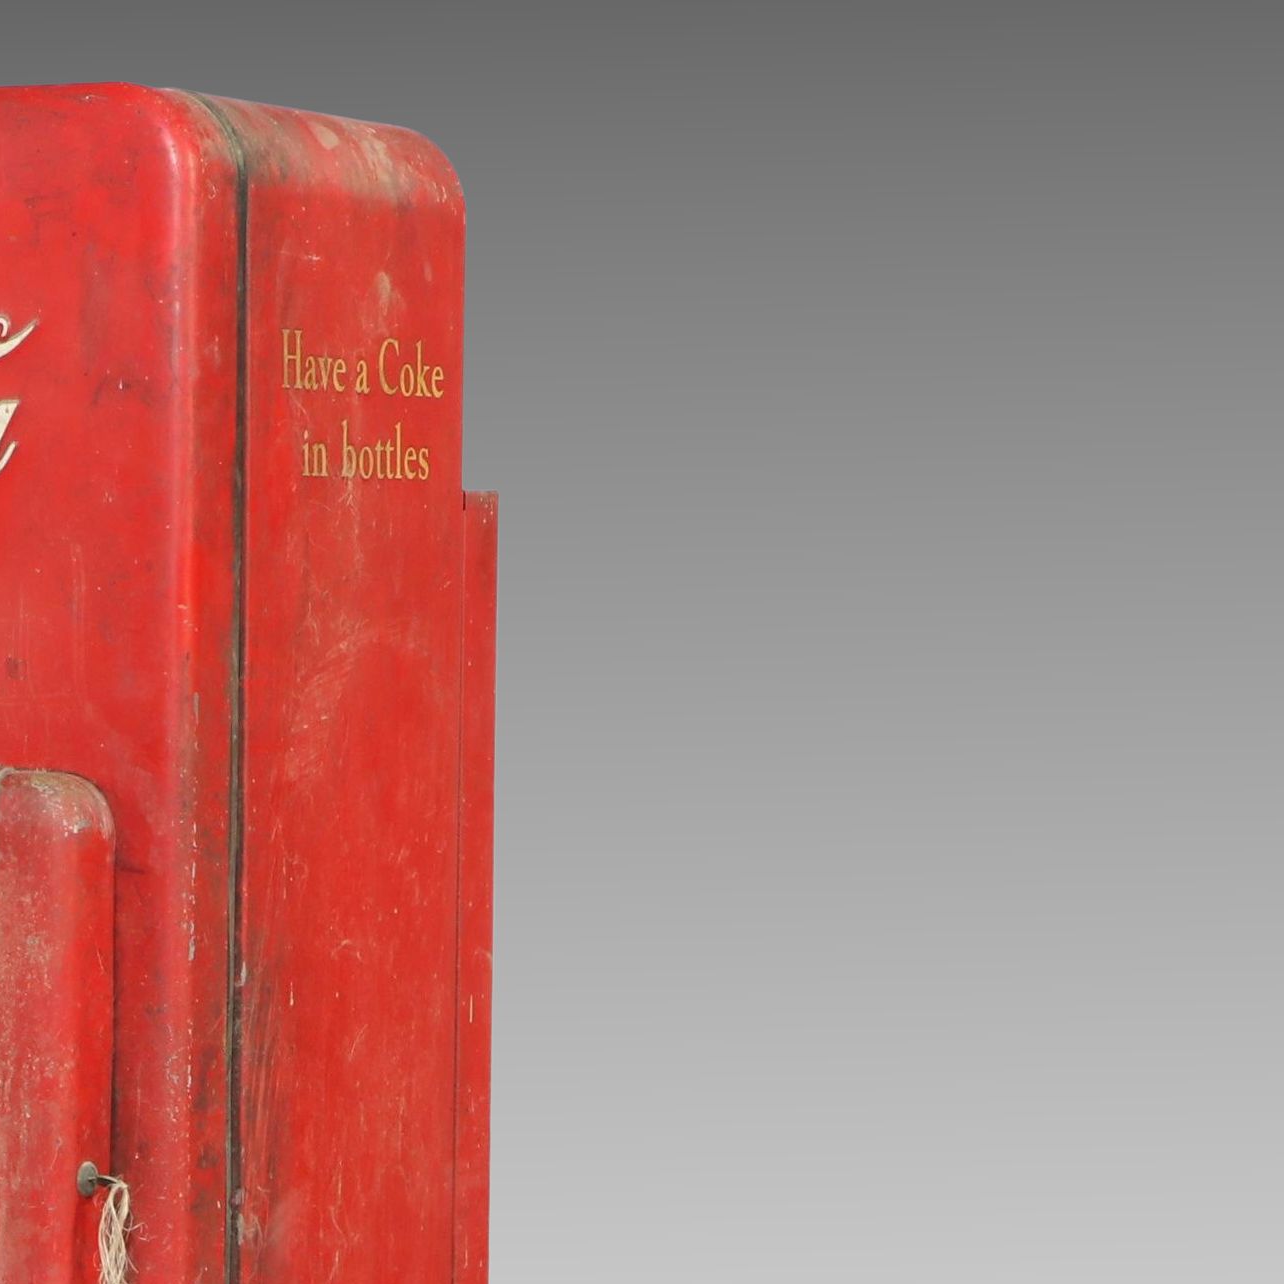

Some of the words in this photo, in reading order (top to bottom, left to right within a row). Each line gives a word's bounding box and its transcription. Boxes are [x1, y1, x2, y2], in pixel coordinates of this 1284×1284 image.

[282, 329, 346, 392] Have
[355, 359, 371, 394] a
[378, 338, 444, 398] Coke
[302, 430, 328, 477] in
[341, 419, 430, 480] bottles
